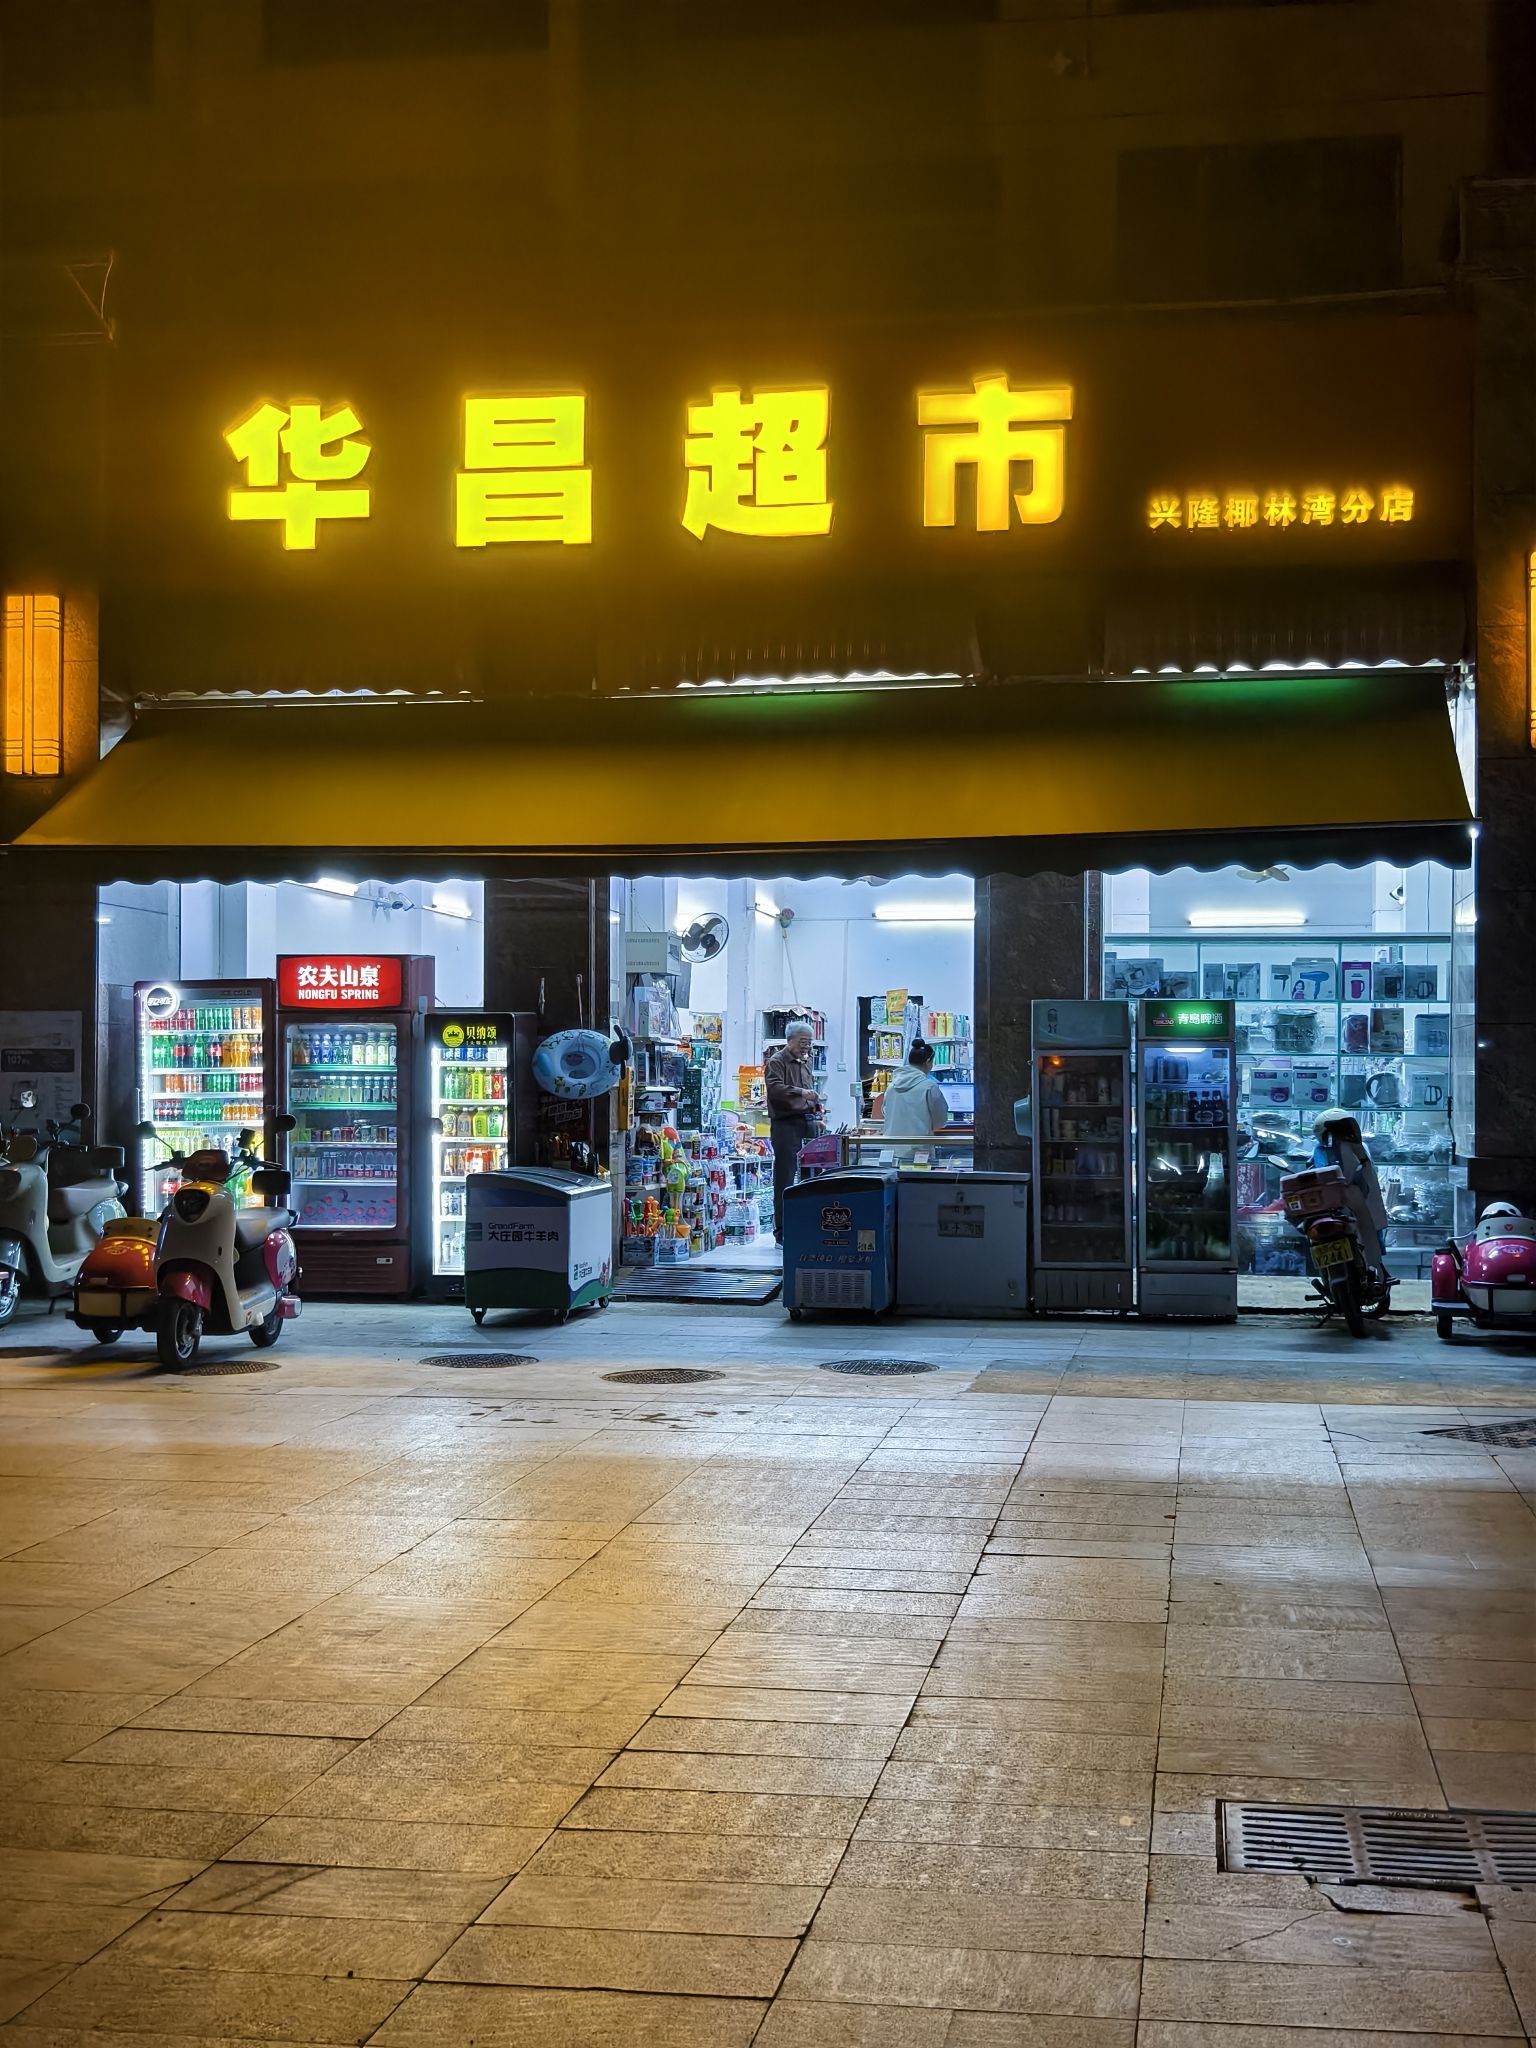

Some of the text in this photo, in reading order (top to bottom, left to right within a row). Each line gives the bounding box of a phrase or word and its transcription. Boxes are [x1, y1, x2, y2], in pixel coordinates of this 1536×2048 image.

[224, 376, 1073, 550] 华昌超市
[1149, 487, 1415, 529] 兴隆椰林湾分店
[297, 965, 380, 987] 农夫山泉
[298, 989, 379, 1000] NONGFU SPRING
[1177, 1012, 1223, 1025] 青岛啤酒
[466, 1026, 497, 1040] 贝纳颂
[488, 1222, 535, 1230] GrandFarm
[488, 1230, 560, 1242] 大庄园牛羊肉
